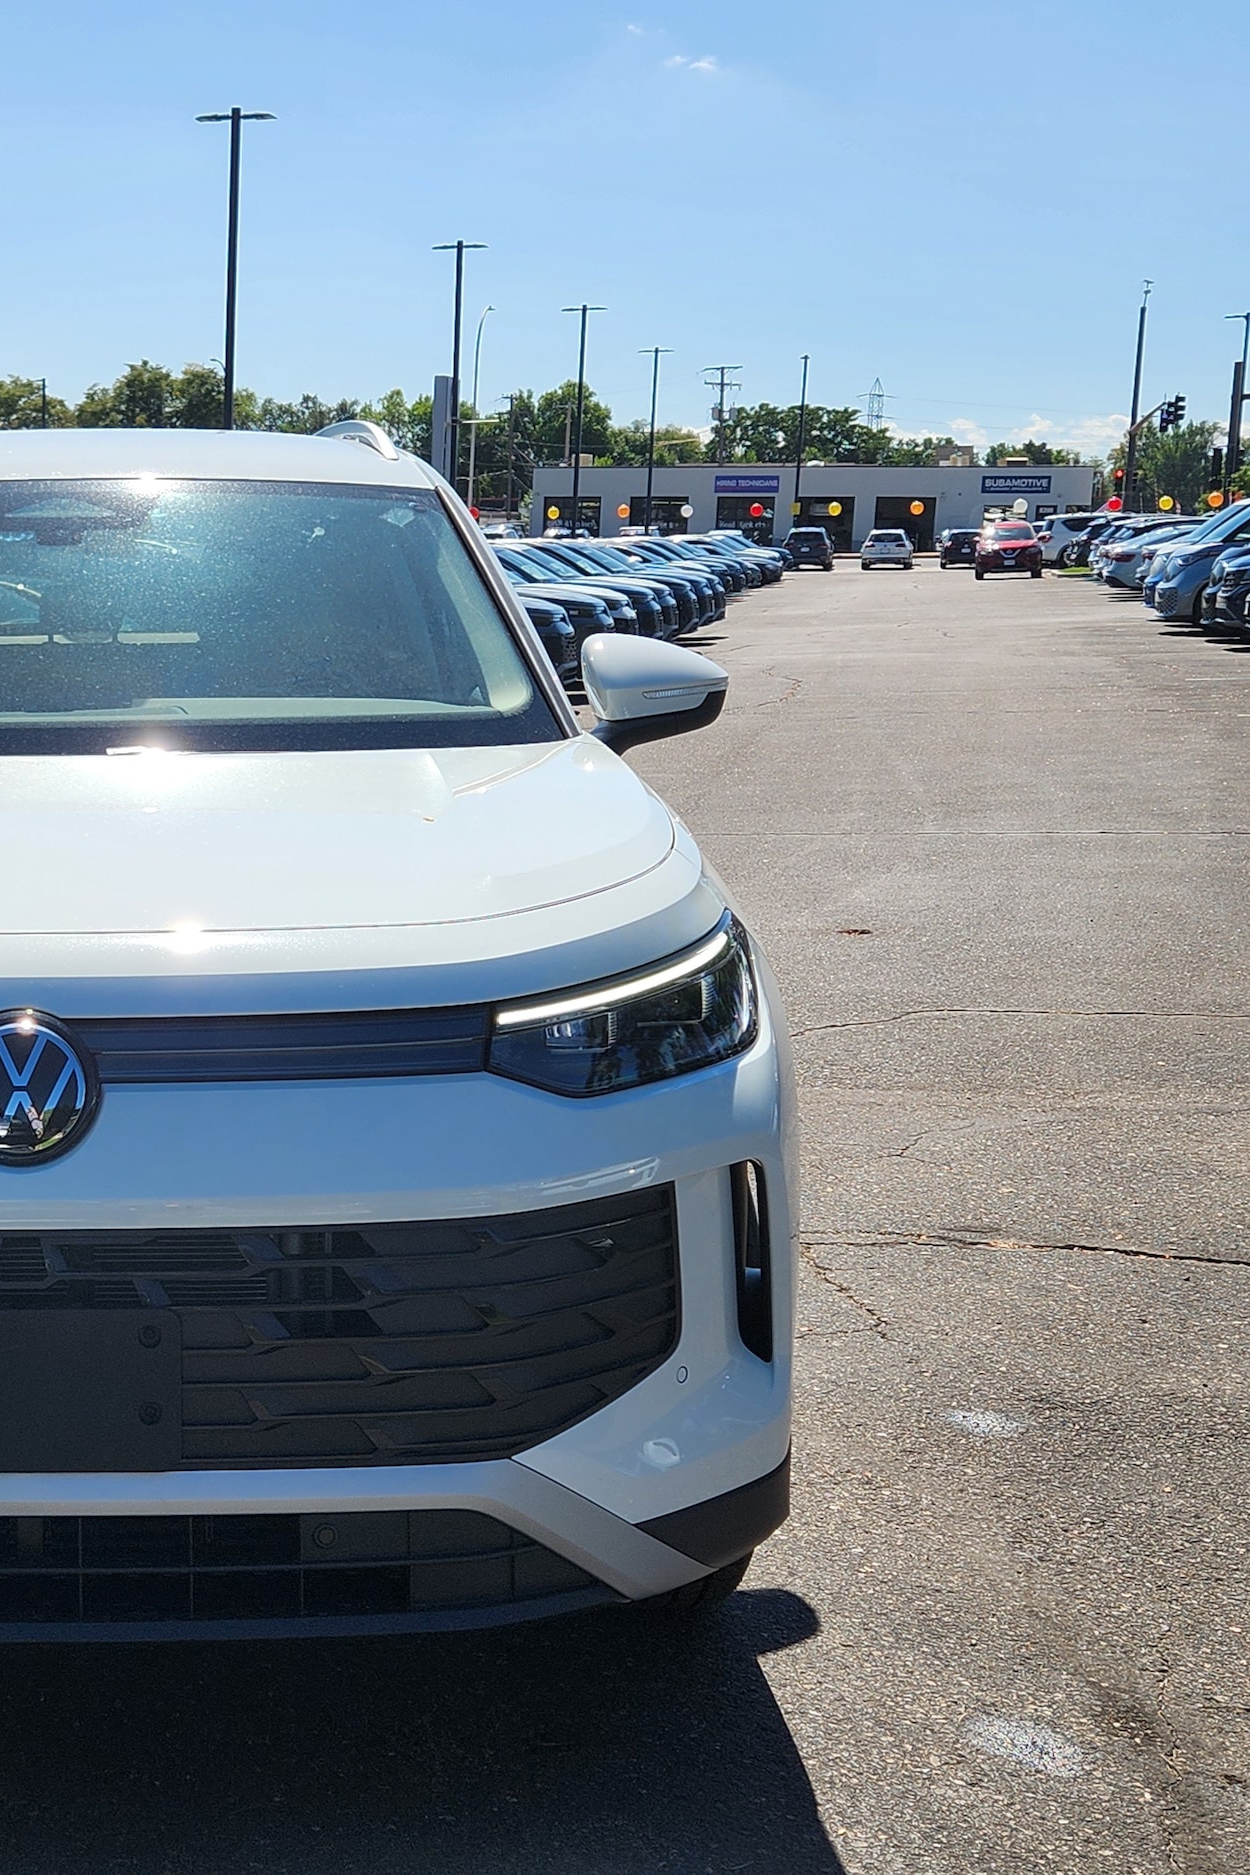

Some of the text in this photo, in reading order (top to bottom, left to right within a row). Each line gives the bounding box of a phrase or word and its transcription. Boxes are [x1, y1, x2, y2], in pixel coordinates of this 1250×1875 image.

[716, 479, 778, 487] HIRING TECHNICIANS
[985, 478, 1049, 487] SUBAMOTIVE
